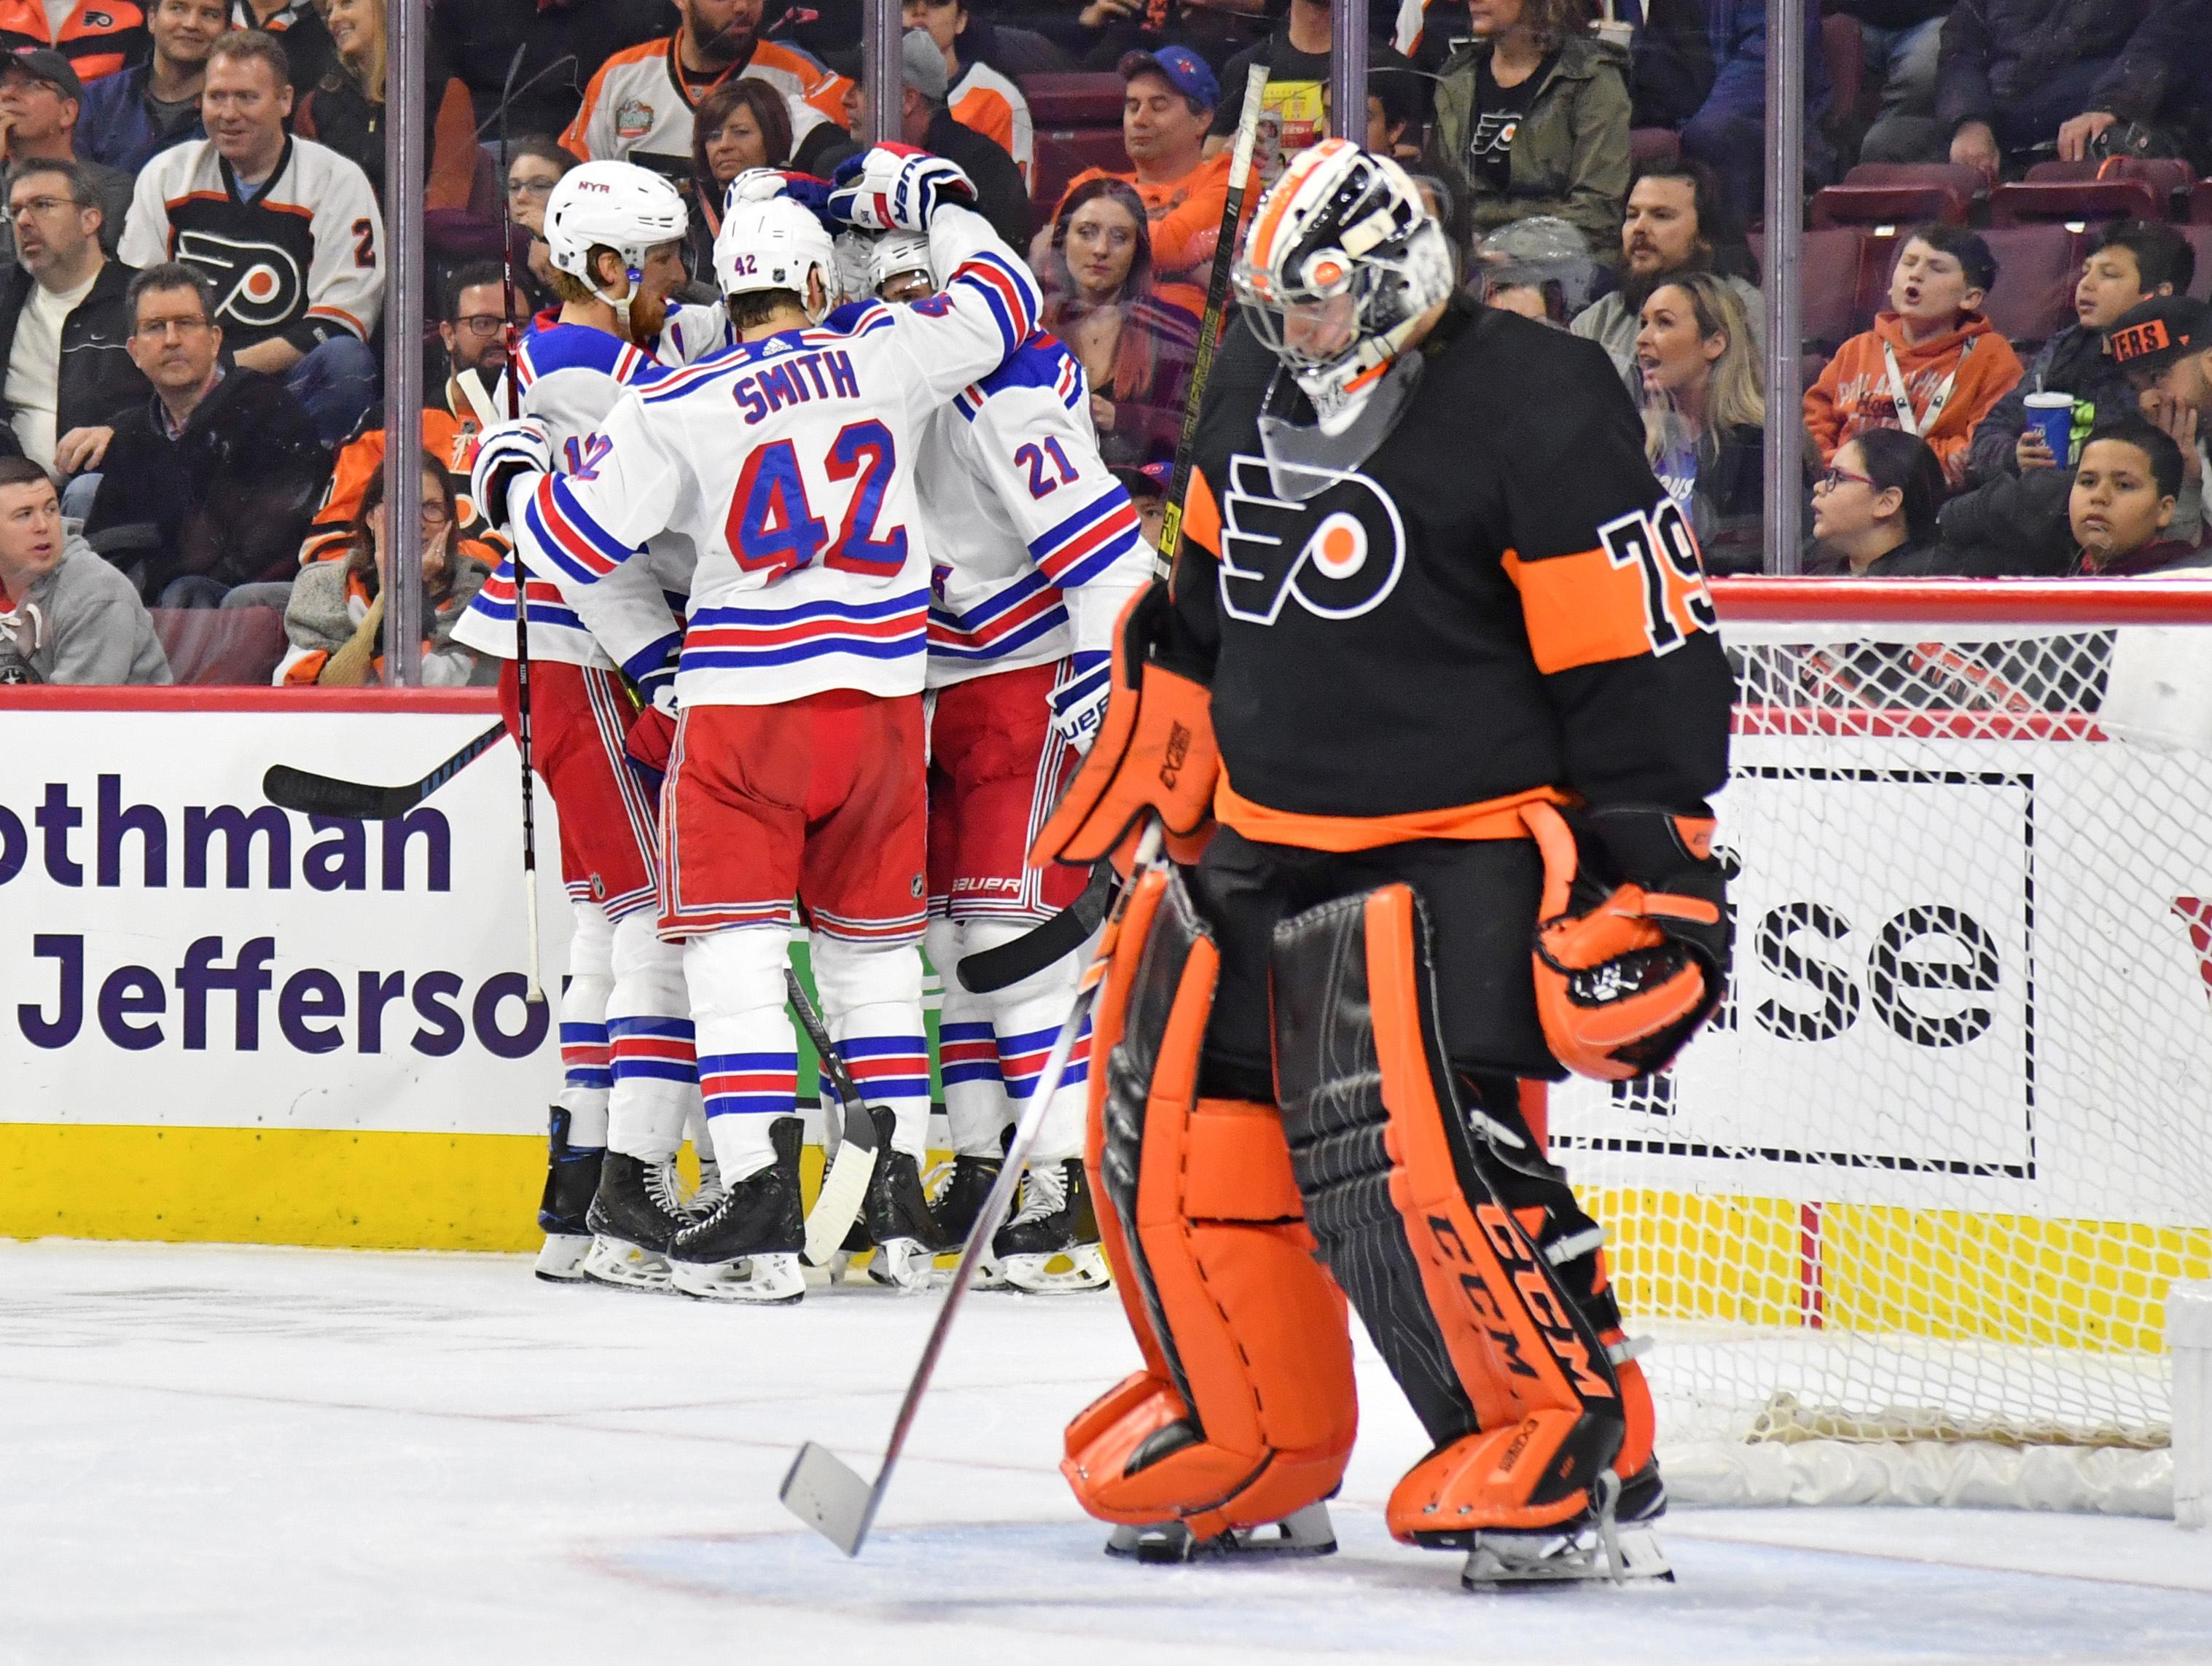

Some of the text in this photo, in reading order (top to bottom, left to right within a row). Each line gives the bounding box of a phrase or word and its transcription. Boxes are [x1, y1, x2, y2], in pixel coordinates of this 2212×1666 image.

[578, 181, 610, 194] NYR
[735, 254, 757, 277] 42
[732, 350, 860, 425] SMITH
[724, 418, 908, 585] 42
[1014, 435, 1079, 501] 21
[1596, 496, 1719, 658] 79
[17, 934, 573, 1059] Jefferso
[1427, 1214, 1539, 1380] CCM
[1477, 1202, 1615, 1398] CCM
